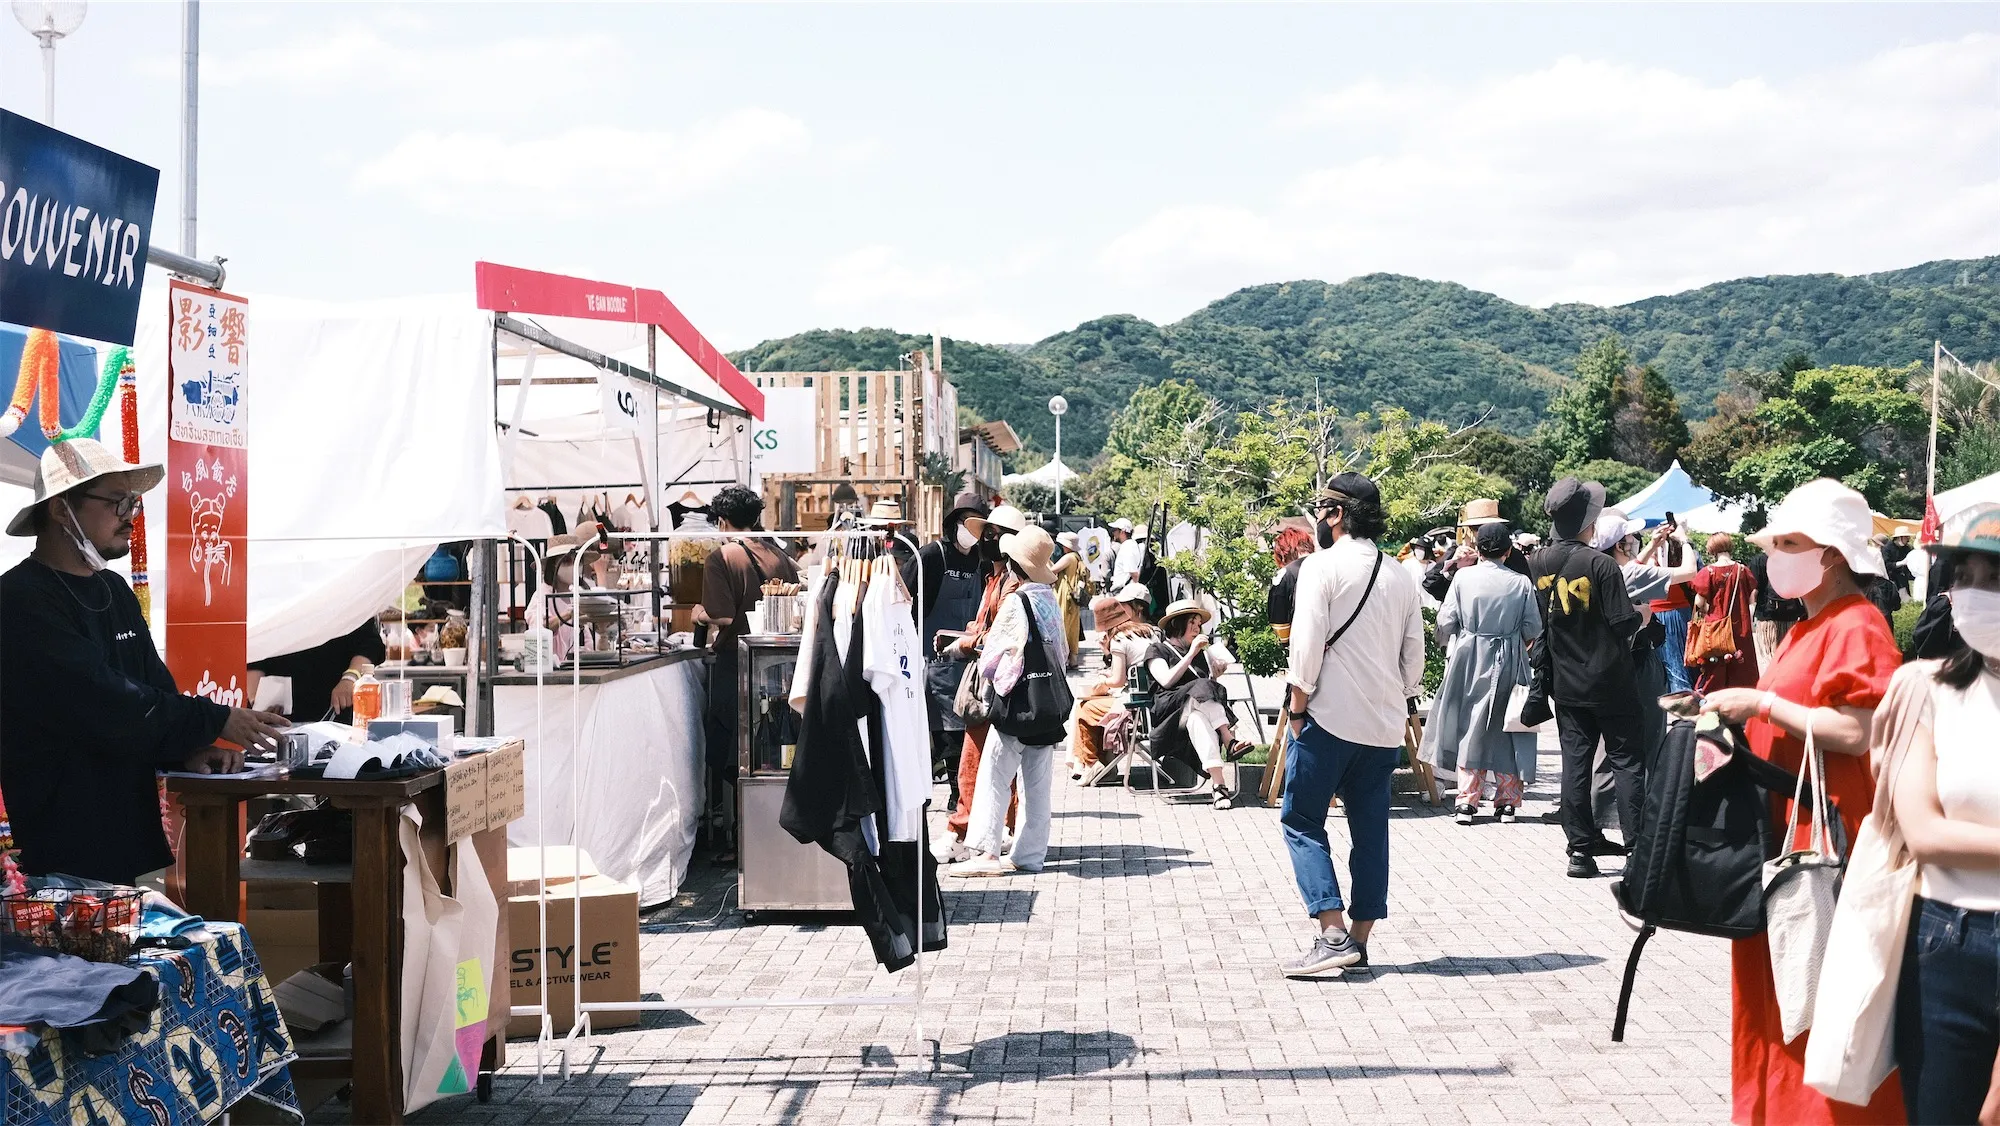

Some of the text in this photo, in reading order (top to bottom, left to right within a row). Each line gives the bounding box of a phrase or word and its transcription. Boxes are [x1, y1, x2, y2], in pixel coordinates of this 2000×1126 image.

[0, 181, 140, 289] OUVENIR
[510, 942, 612, 974] STYE
[525, 978, 533, 987] &
